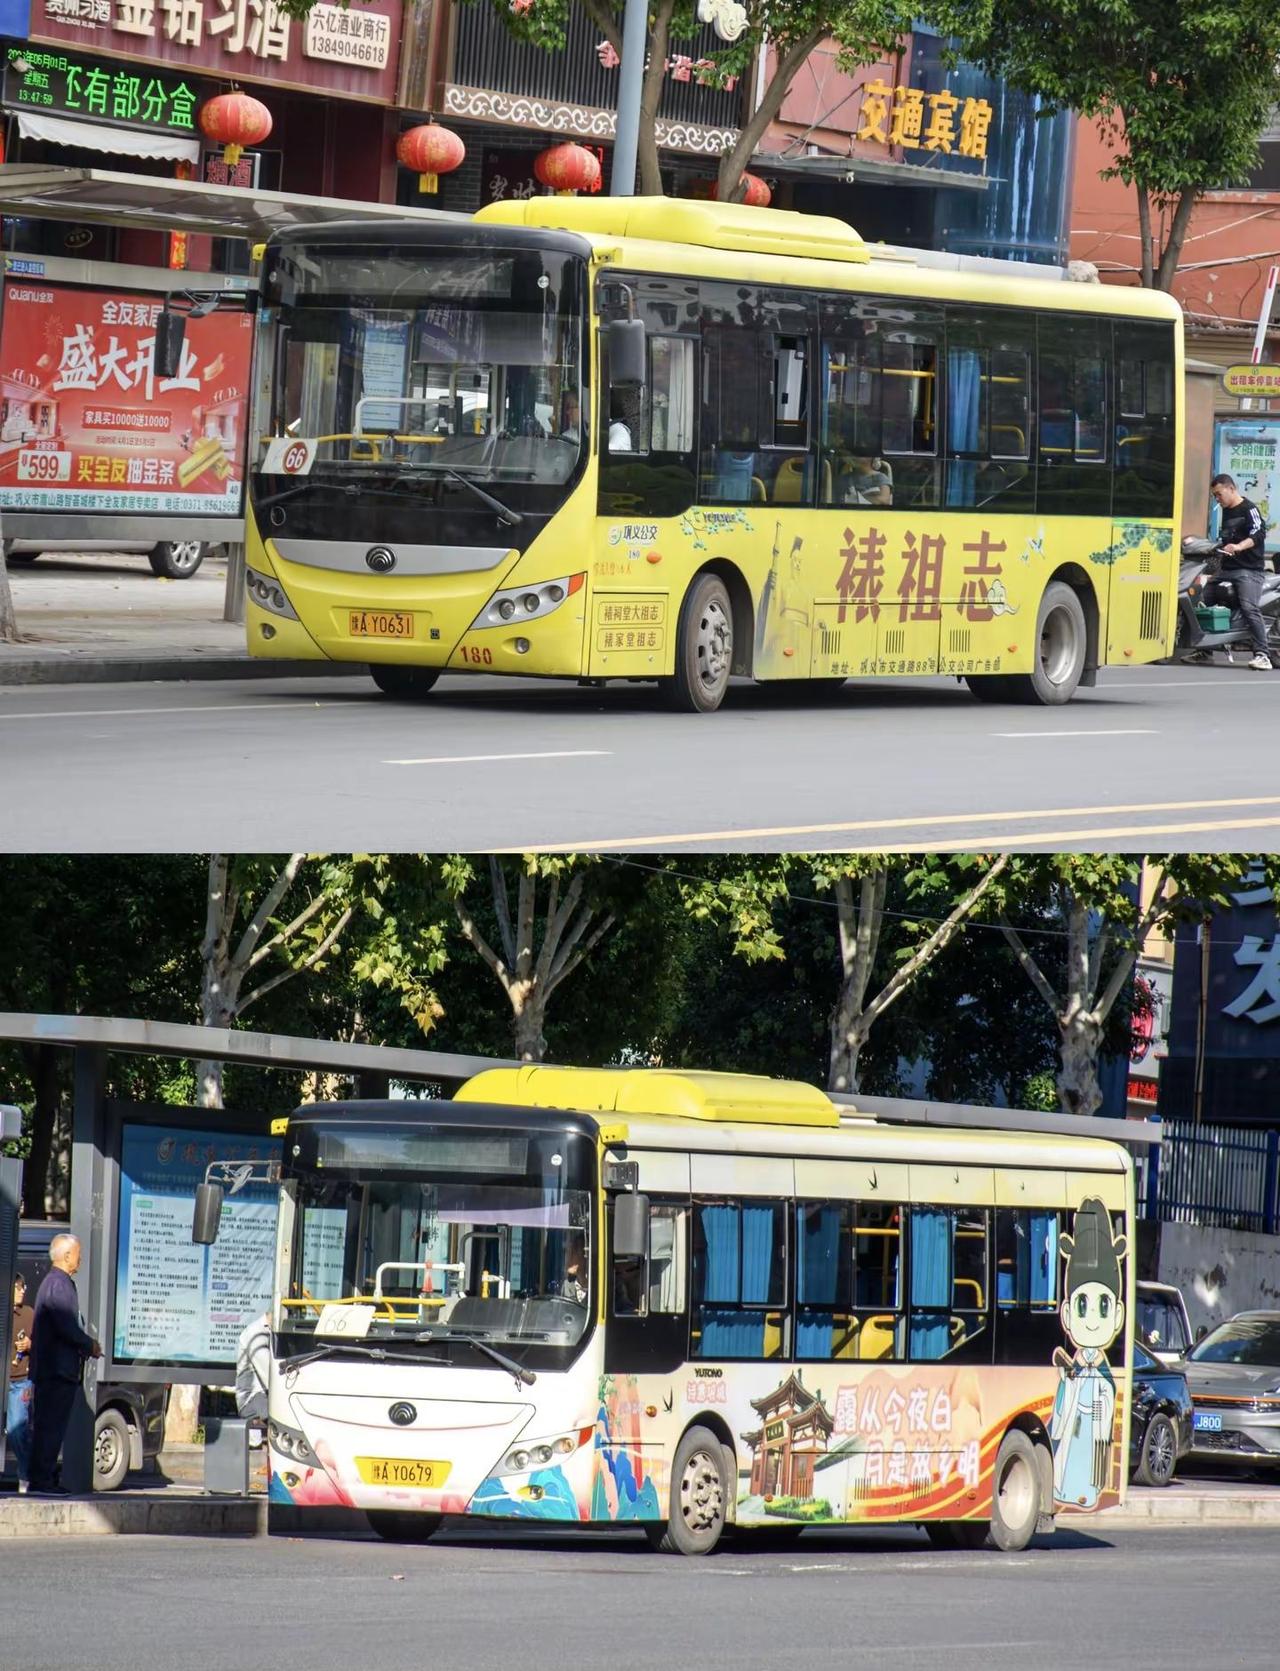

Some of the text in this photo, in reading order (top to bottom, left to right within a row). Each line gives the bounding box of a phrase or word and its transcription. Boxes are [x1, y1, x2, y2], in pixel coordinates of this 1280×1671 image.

[312, 9, 388, 43] 六亿酒业商行
[311, 35, 386, 64] 13849046618
[857, 79, 993, 159] 交通宾馆
[285, 448, 306, 469] 66
[1231, 444, 1277, 459] 文明健康
[77, 453, 176, 486] 买全友抽金条
[1230, 458, 1276, 472] 有你有我
[623, 525, 658, 540] 巩义公交
[460, 646, 492, 665] 180
[832, 1384, 954, 1436] 露从今夜白
[1194, 1416, 1222, 1429] J800
[863, 1438, 981, 1488] 月是故乡明
